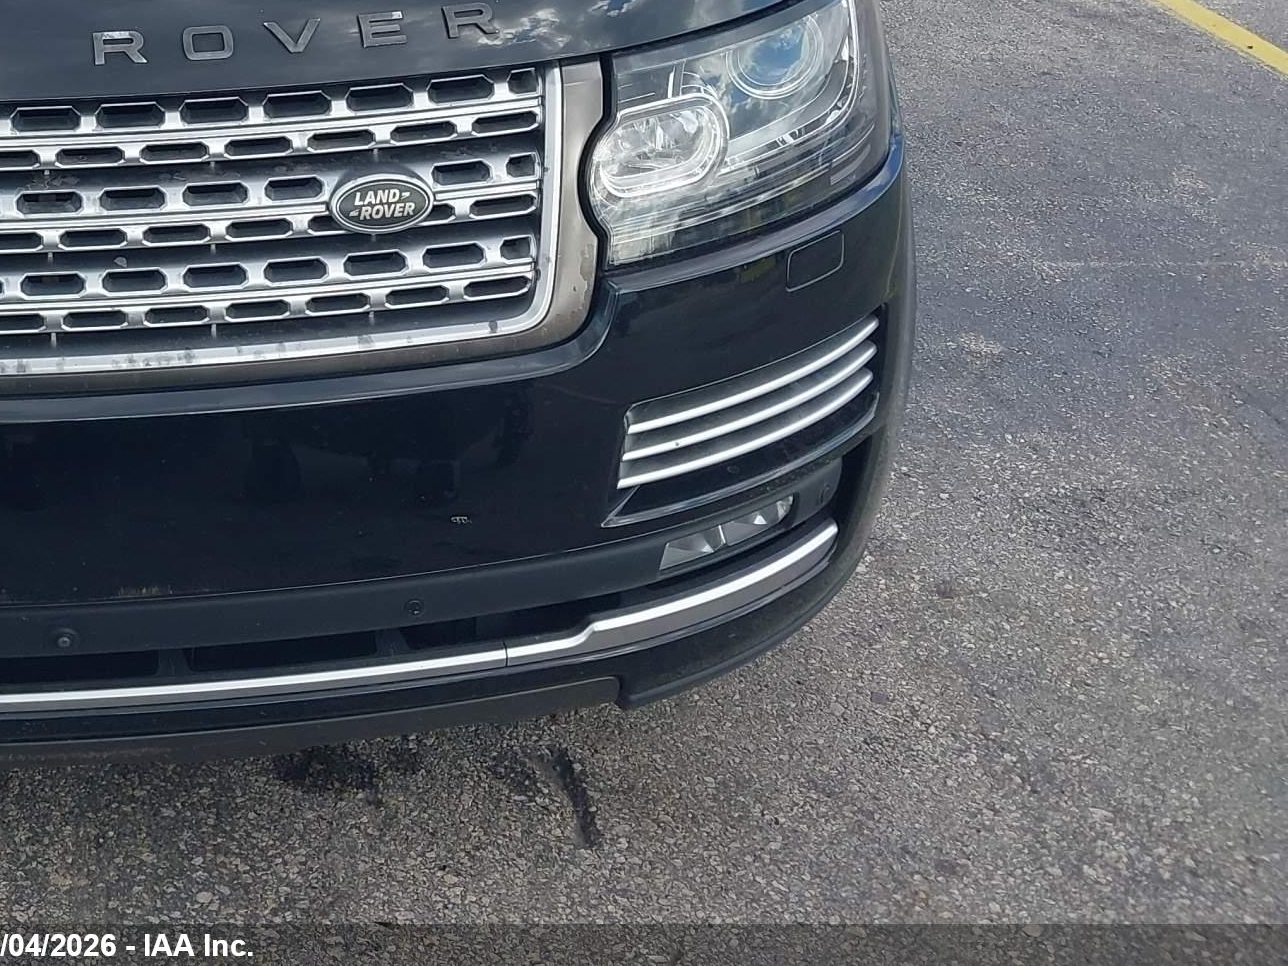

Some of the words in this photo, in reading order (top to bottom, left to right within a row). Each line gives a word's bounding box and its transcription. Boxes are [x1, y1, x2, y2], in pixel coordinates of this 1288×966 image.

[92, 2, 500, 66] ROVER
[353, 188, 400, 206] LAND
[359, 202, 416, 221] ROVER
